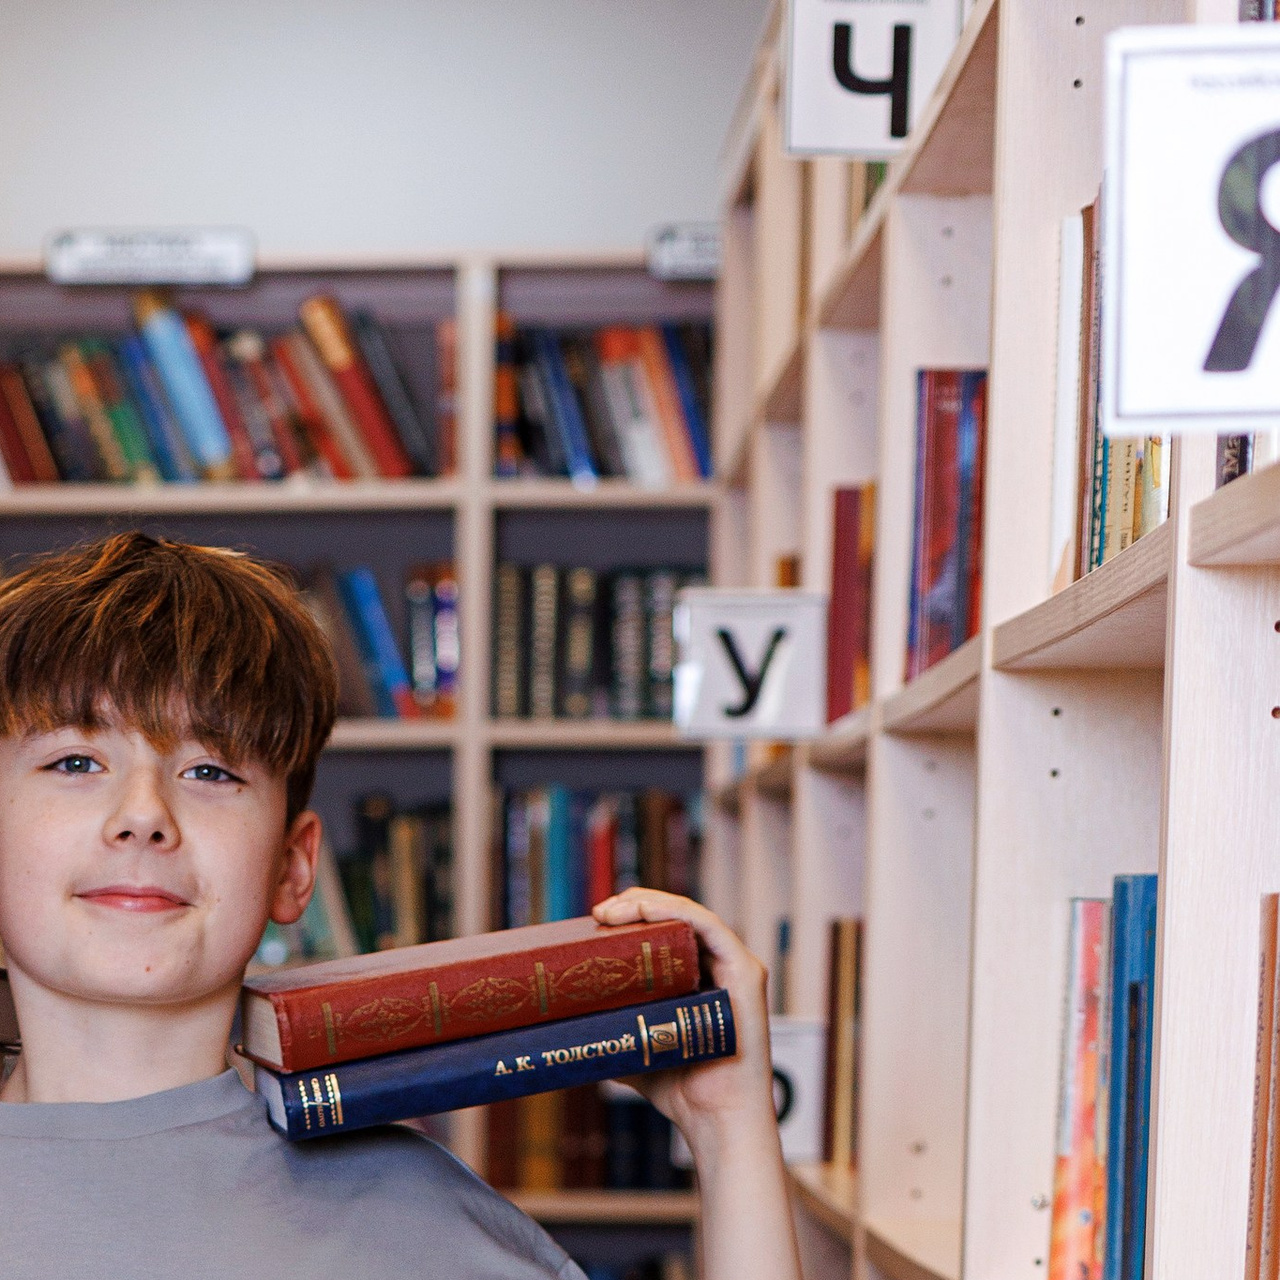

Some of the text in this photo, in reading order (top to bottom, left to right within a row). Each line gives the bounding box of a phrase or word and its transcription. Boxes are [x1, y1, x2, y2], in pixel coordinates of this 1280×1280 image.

[833, 22, 911, 138] Ч
[718, 626, 787, 718] У
[493, 1032, 637, 1077] А. К. ТОЛСТОЙ
